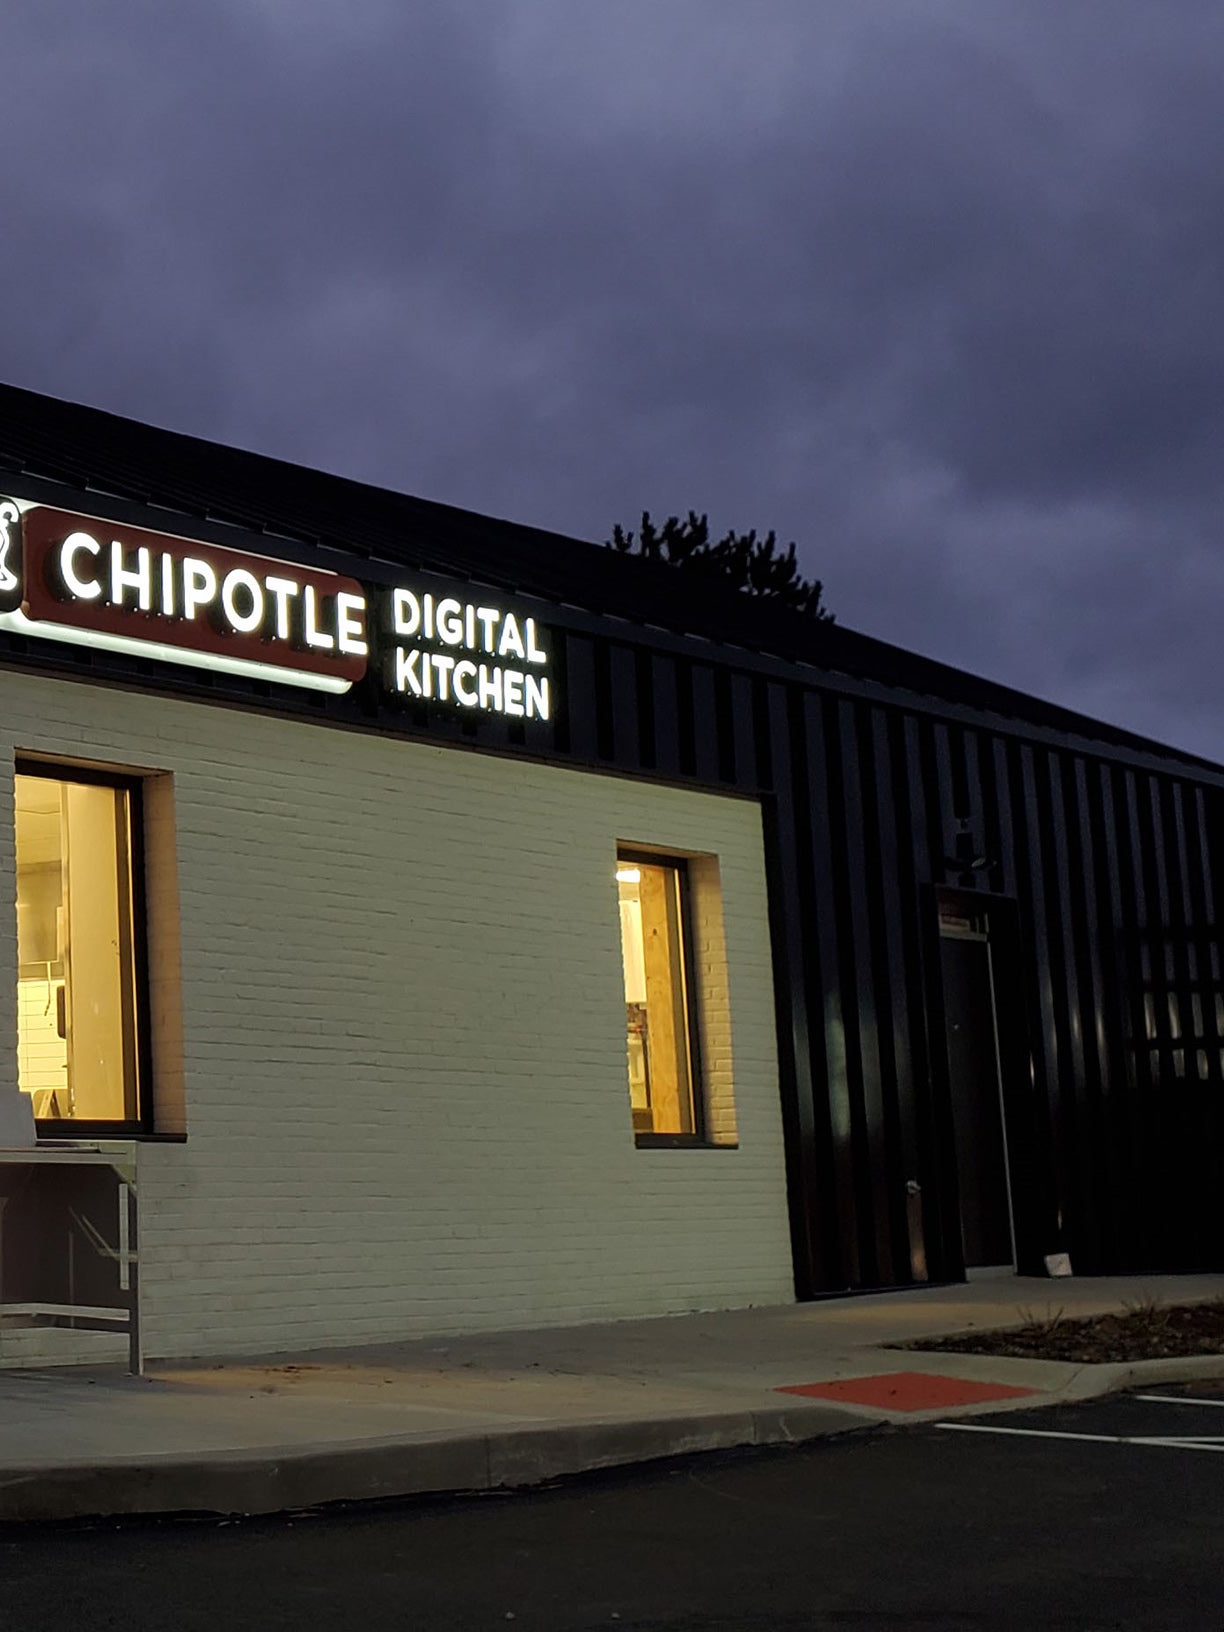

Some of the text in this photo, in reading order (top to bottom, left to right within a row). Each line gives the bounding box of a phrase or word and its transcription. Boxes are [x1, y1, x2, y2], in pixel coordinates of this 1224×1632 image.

[60, 532, 368, 655] CHIPOTLE
[393, 588, 547, 663] DIGITAL
[395, 646, 550, 720] KITCHEN
